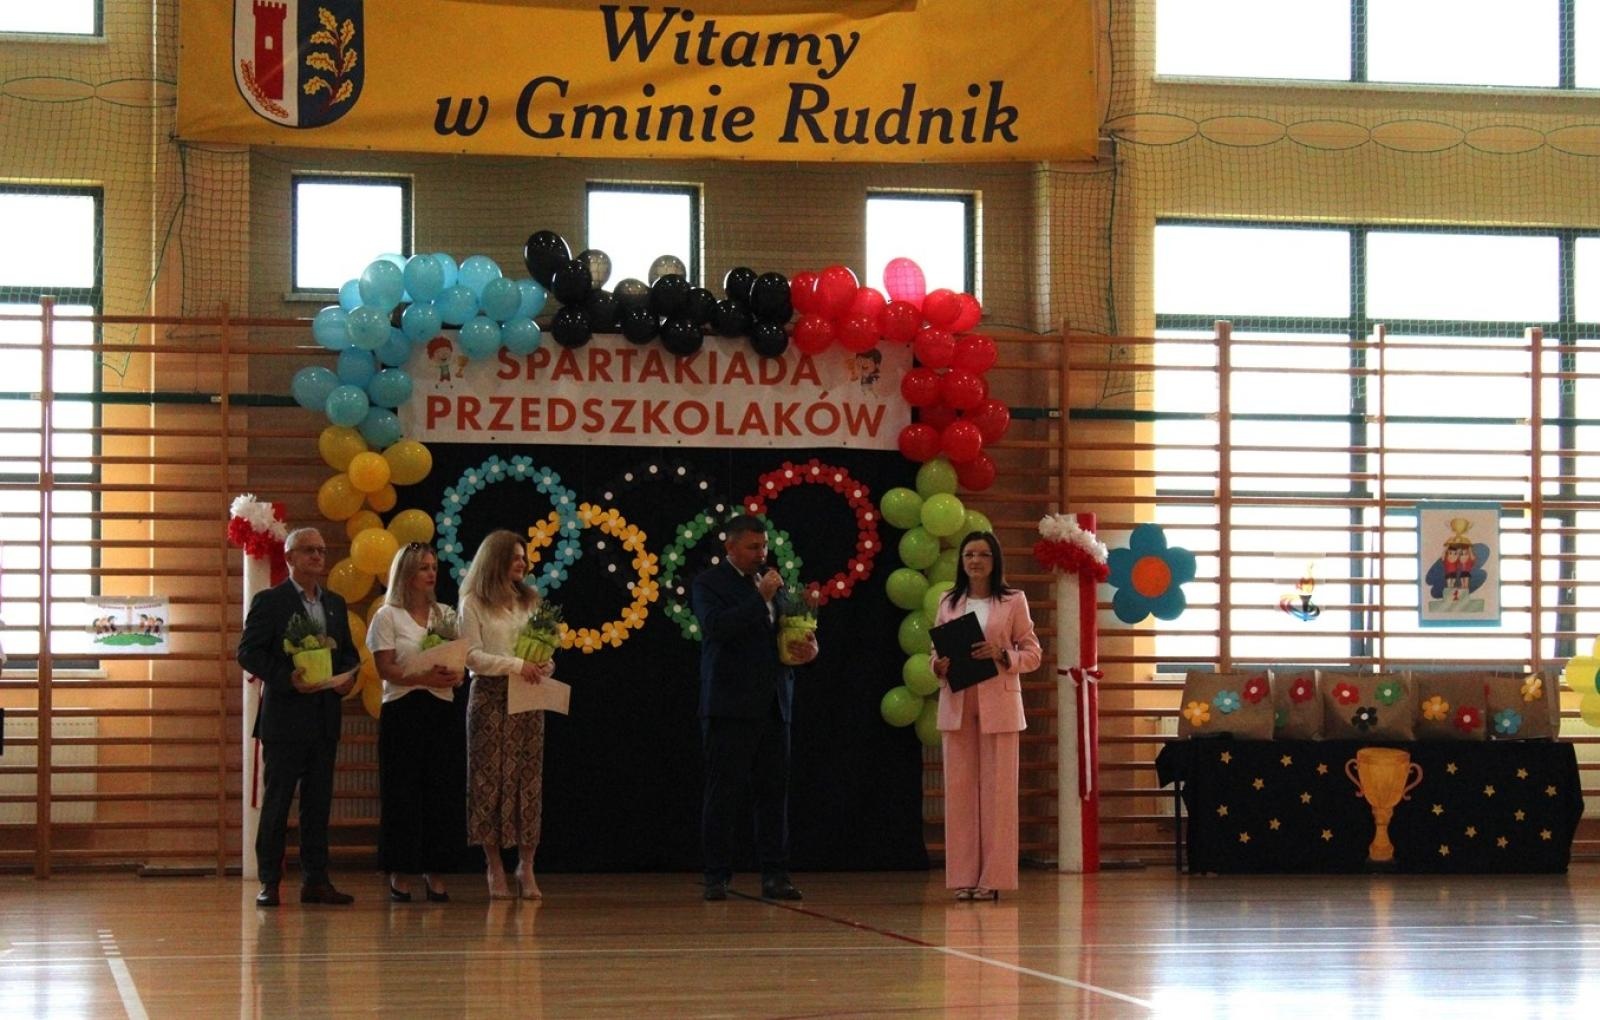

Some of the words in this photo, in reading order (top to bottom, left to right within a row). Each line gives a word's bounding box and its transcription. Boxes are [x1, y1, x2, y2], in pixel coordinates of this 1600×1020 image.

[600, 5, 860, 80] Witamy
[434, 95, 489, 136] w
[515, 76, 756, 142] Gminie
[779, 81, 1018, 145] Rudnik
[496, 346, 822, 386] SPARTAKIADA
[426, 392, 887, 438] PRZEDSZKOLAKÓW
